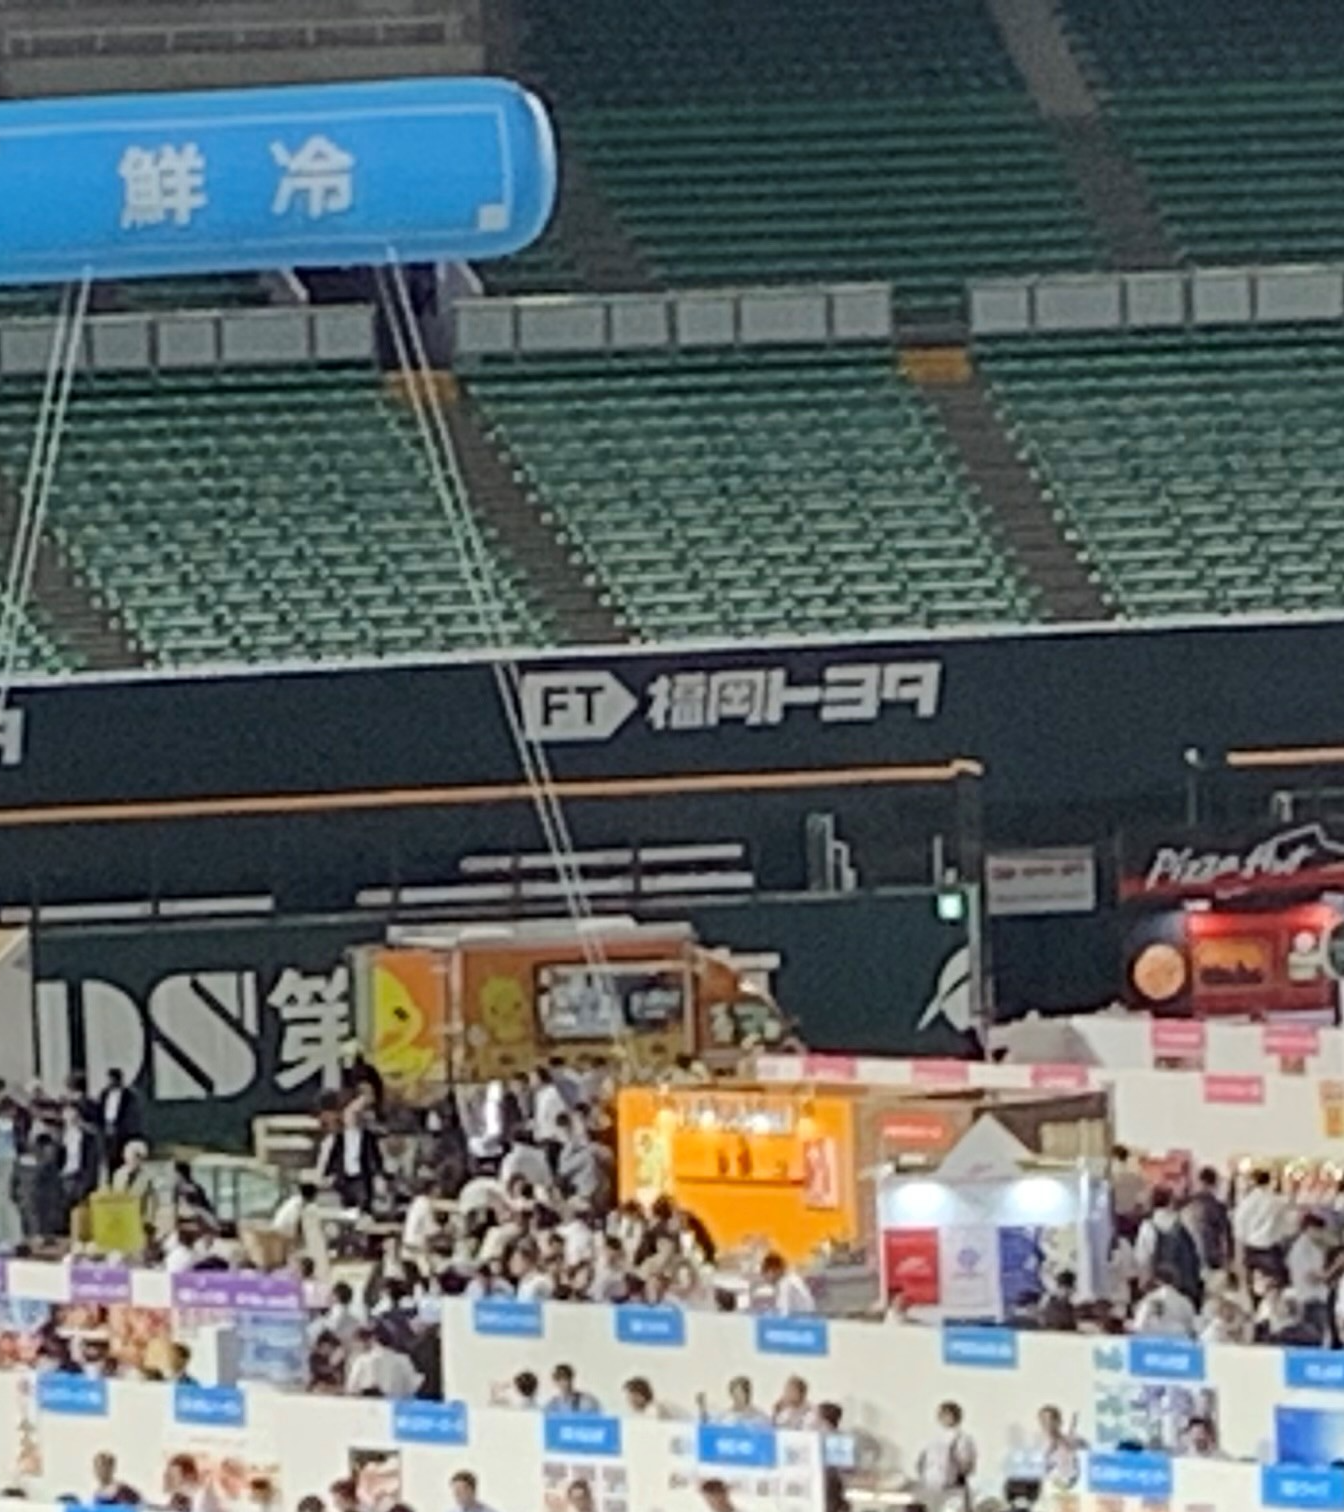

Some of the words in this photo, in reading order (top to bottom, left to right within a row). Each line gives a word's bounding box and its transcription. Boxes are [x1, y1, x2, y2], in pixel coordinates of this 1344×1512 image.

[541, 682, 607, 726] FT
[648, 660, 941, 731] 福岡トヨタ
